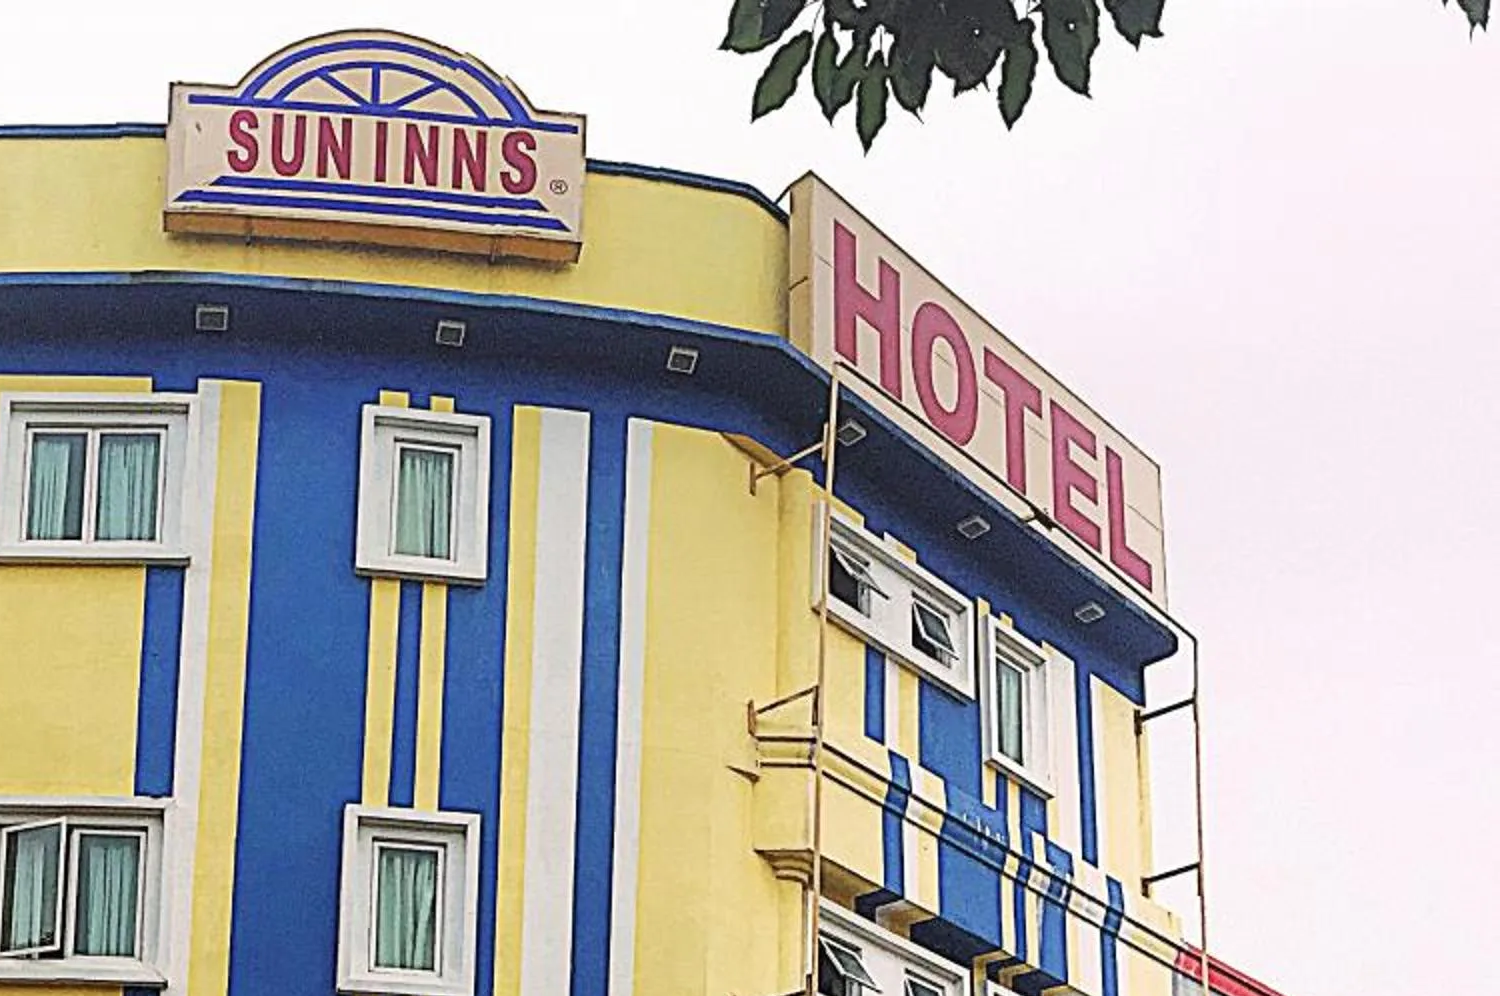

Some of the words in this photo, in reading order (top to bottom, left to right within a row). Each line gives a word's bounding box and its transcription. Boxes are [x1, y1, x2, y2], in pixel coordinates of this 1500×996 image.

[227, 110, 352, 181] SUN
[374, 120, 537, 196] INNS
[834, 219, 1153, 593] HOTEL
